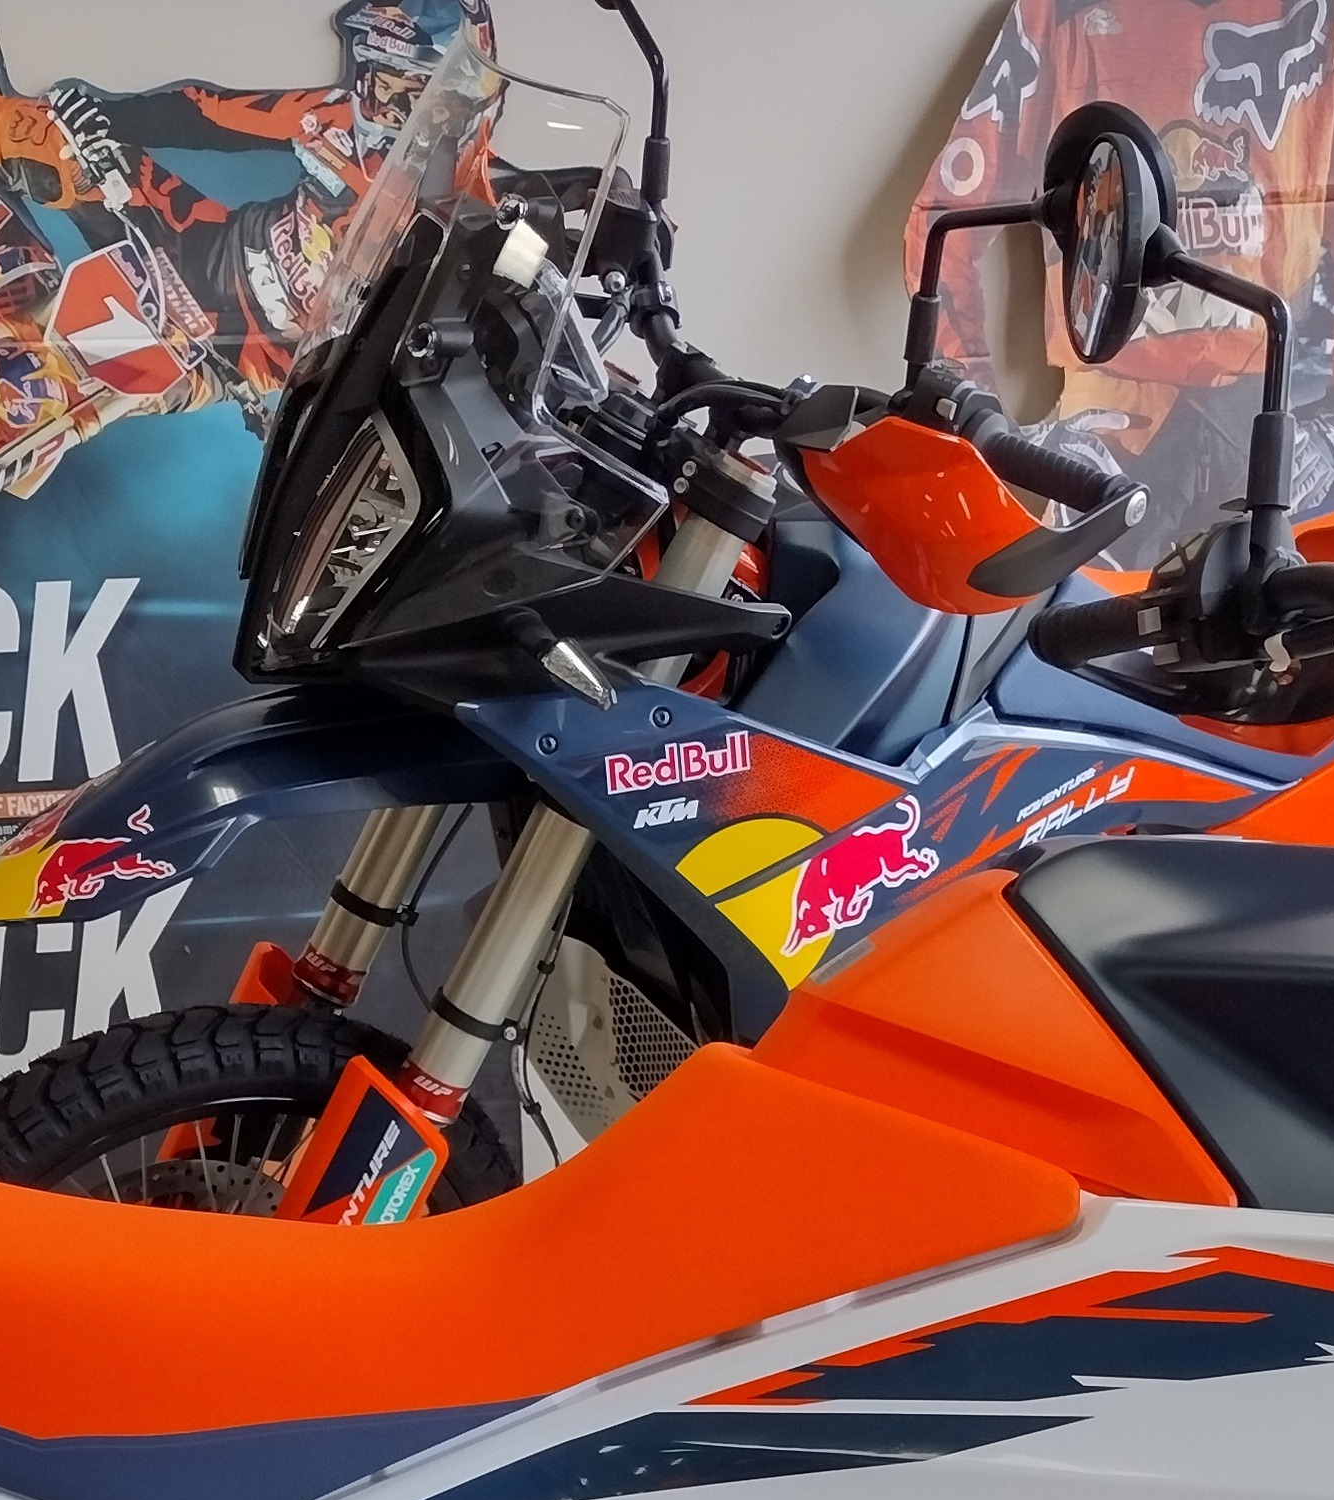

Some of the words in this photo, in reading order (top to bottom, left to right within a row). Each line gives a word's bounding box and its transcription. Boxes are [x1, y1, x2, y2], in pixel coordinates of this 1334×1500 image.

[606, 743, 680, 795] Red
[679, 730, 751, 782] Bull
[633, 797, 699, 829] KTM
[1019, 765, 1136, 850] RALLY
[304, 951, 338, 973] WP
[412, 1074, 454, 1096] WP
